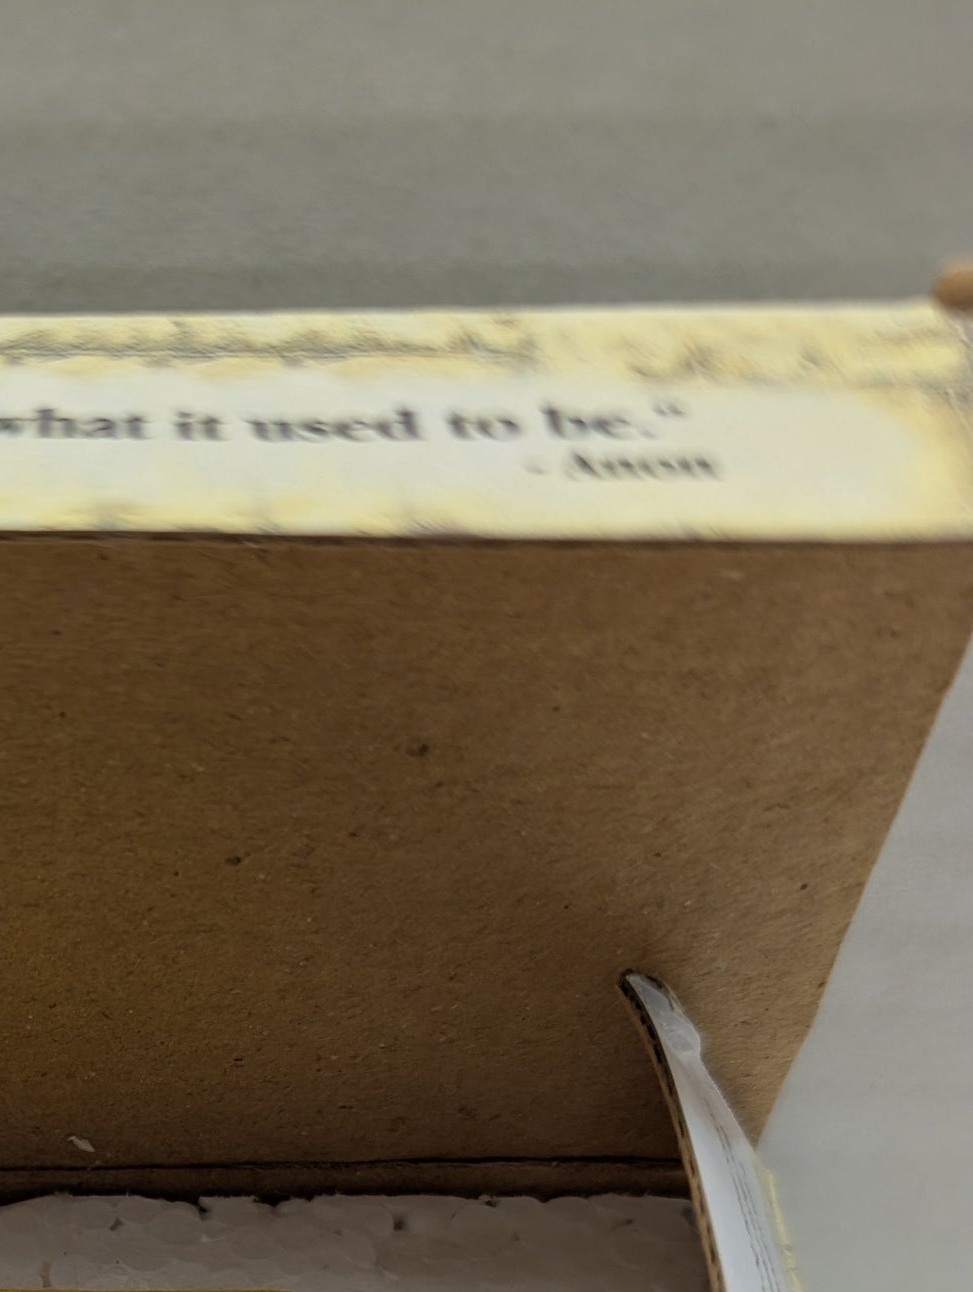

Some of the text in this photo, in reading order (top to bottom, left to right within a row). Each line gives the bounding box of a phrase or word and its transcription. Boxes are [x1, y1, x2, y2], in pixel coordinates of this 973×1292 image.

[172, 409, 228, 442] it
[242, 407, 425, 443] used
[444, 410, 522, 442] to
[564, 448, 725, 482] Anon
